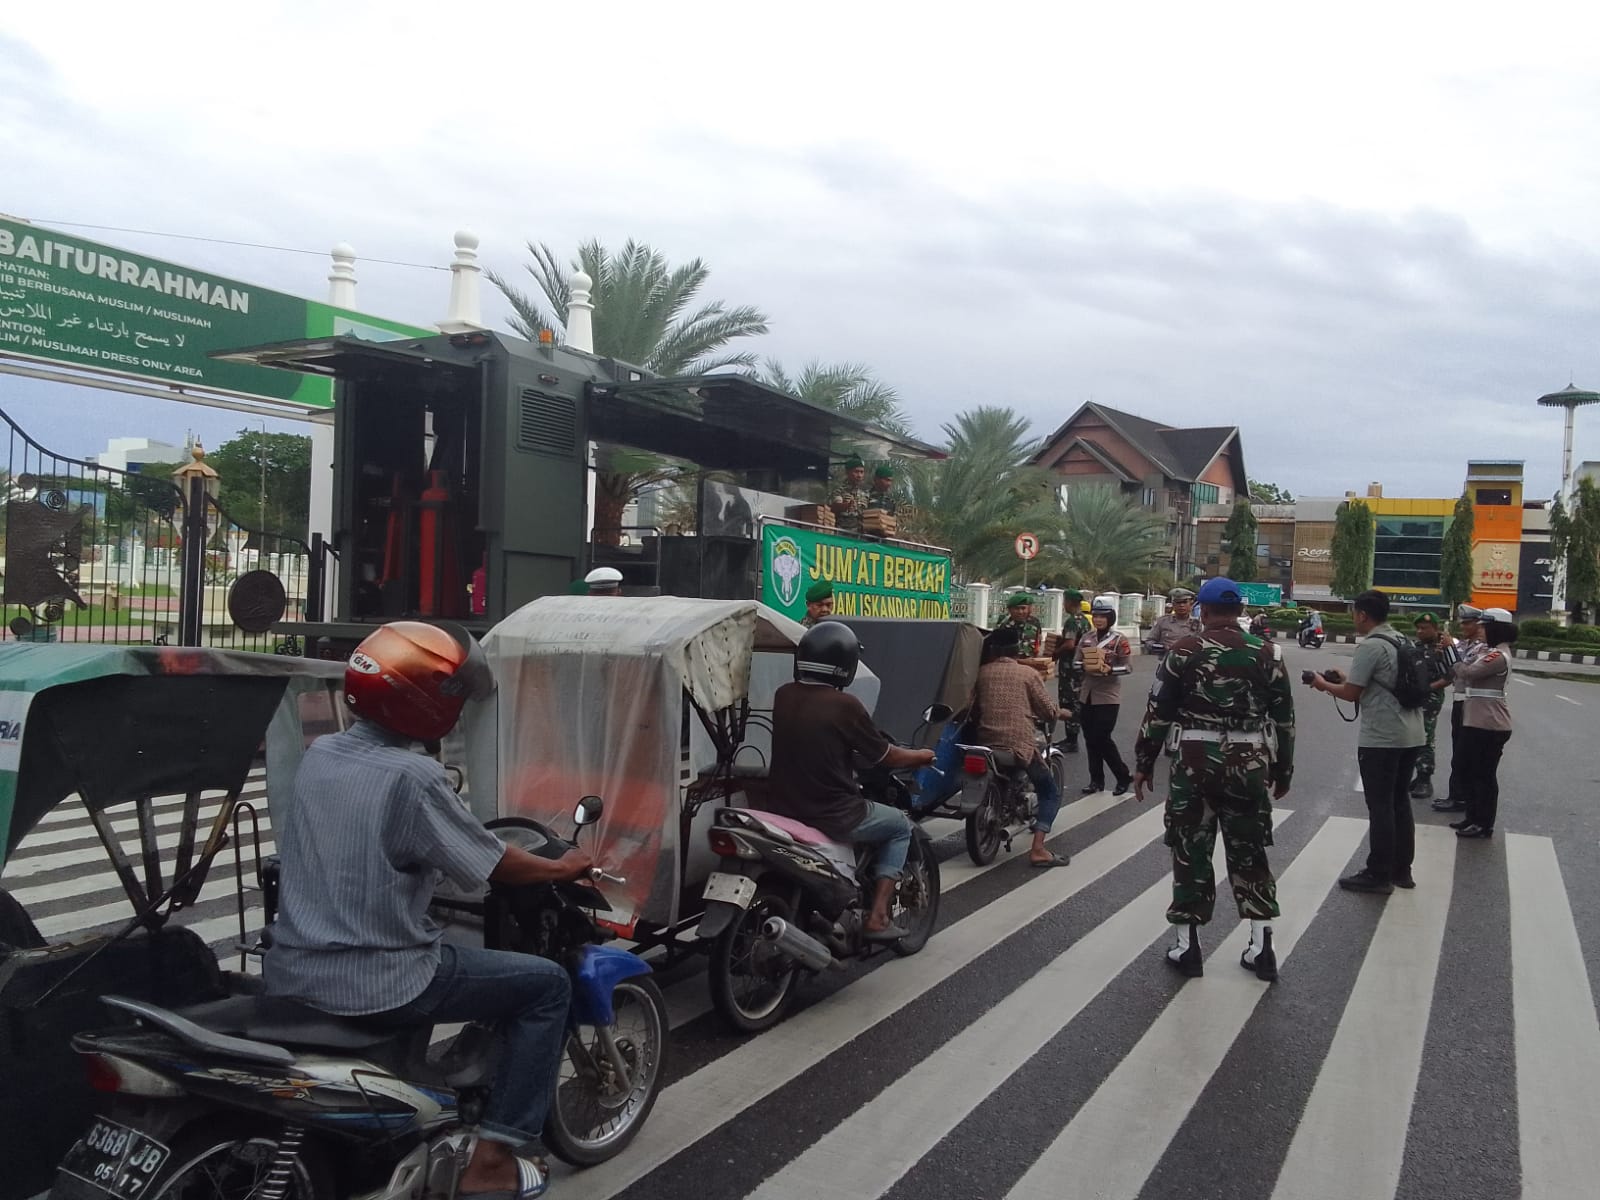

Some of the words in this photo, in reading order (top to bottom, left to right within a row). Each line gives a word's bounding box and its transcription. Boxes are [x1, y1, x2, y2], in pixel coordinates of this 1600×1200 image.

[0, 229, 249, 314] BAITURRAHMAN
[18, 277, 95, 302] BERBUSANA
[98, 295, 144, 315] MUSLIM
[153, 309, 211, 329] MUSLIMAH
[32, 338, 98, 357] MUSLIMAH
[101, 351, 139, 365] DRESS
[142, 359, 172, 371] ONLY
[174, 365, 203, 377] AREA
[809, 543, 880, 586] JUM'AT
[883, 555, 945, 594] BERKAH
[860, 594, 917, 619] ISKANDAR
[919, 599, 950, 620] MUDA
[353, 656, 373, 671] GM
